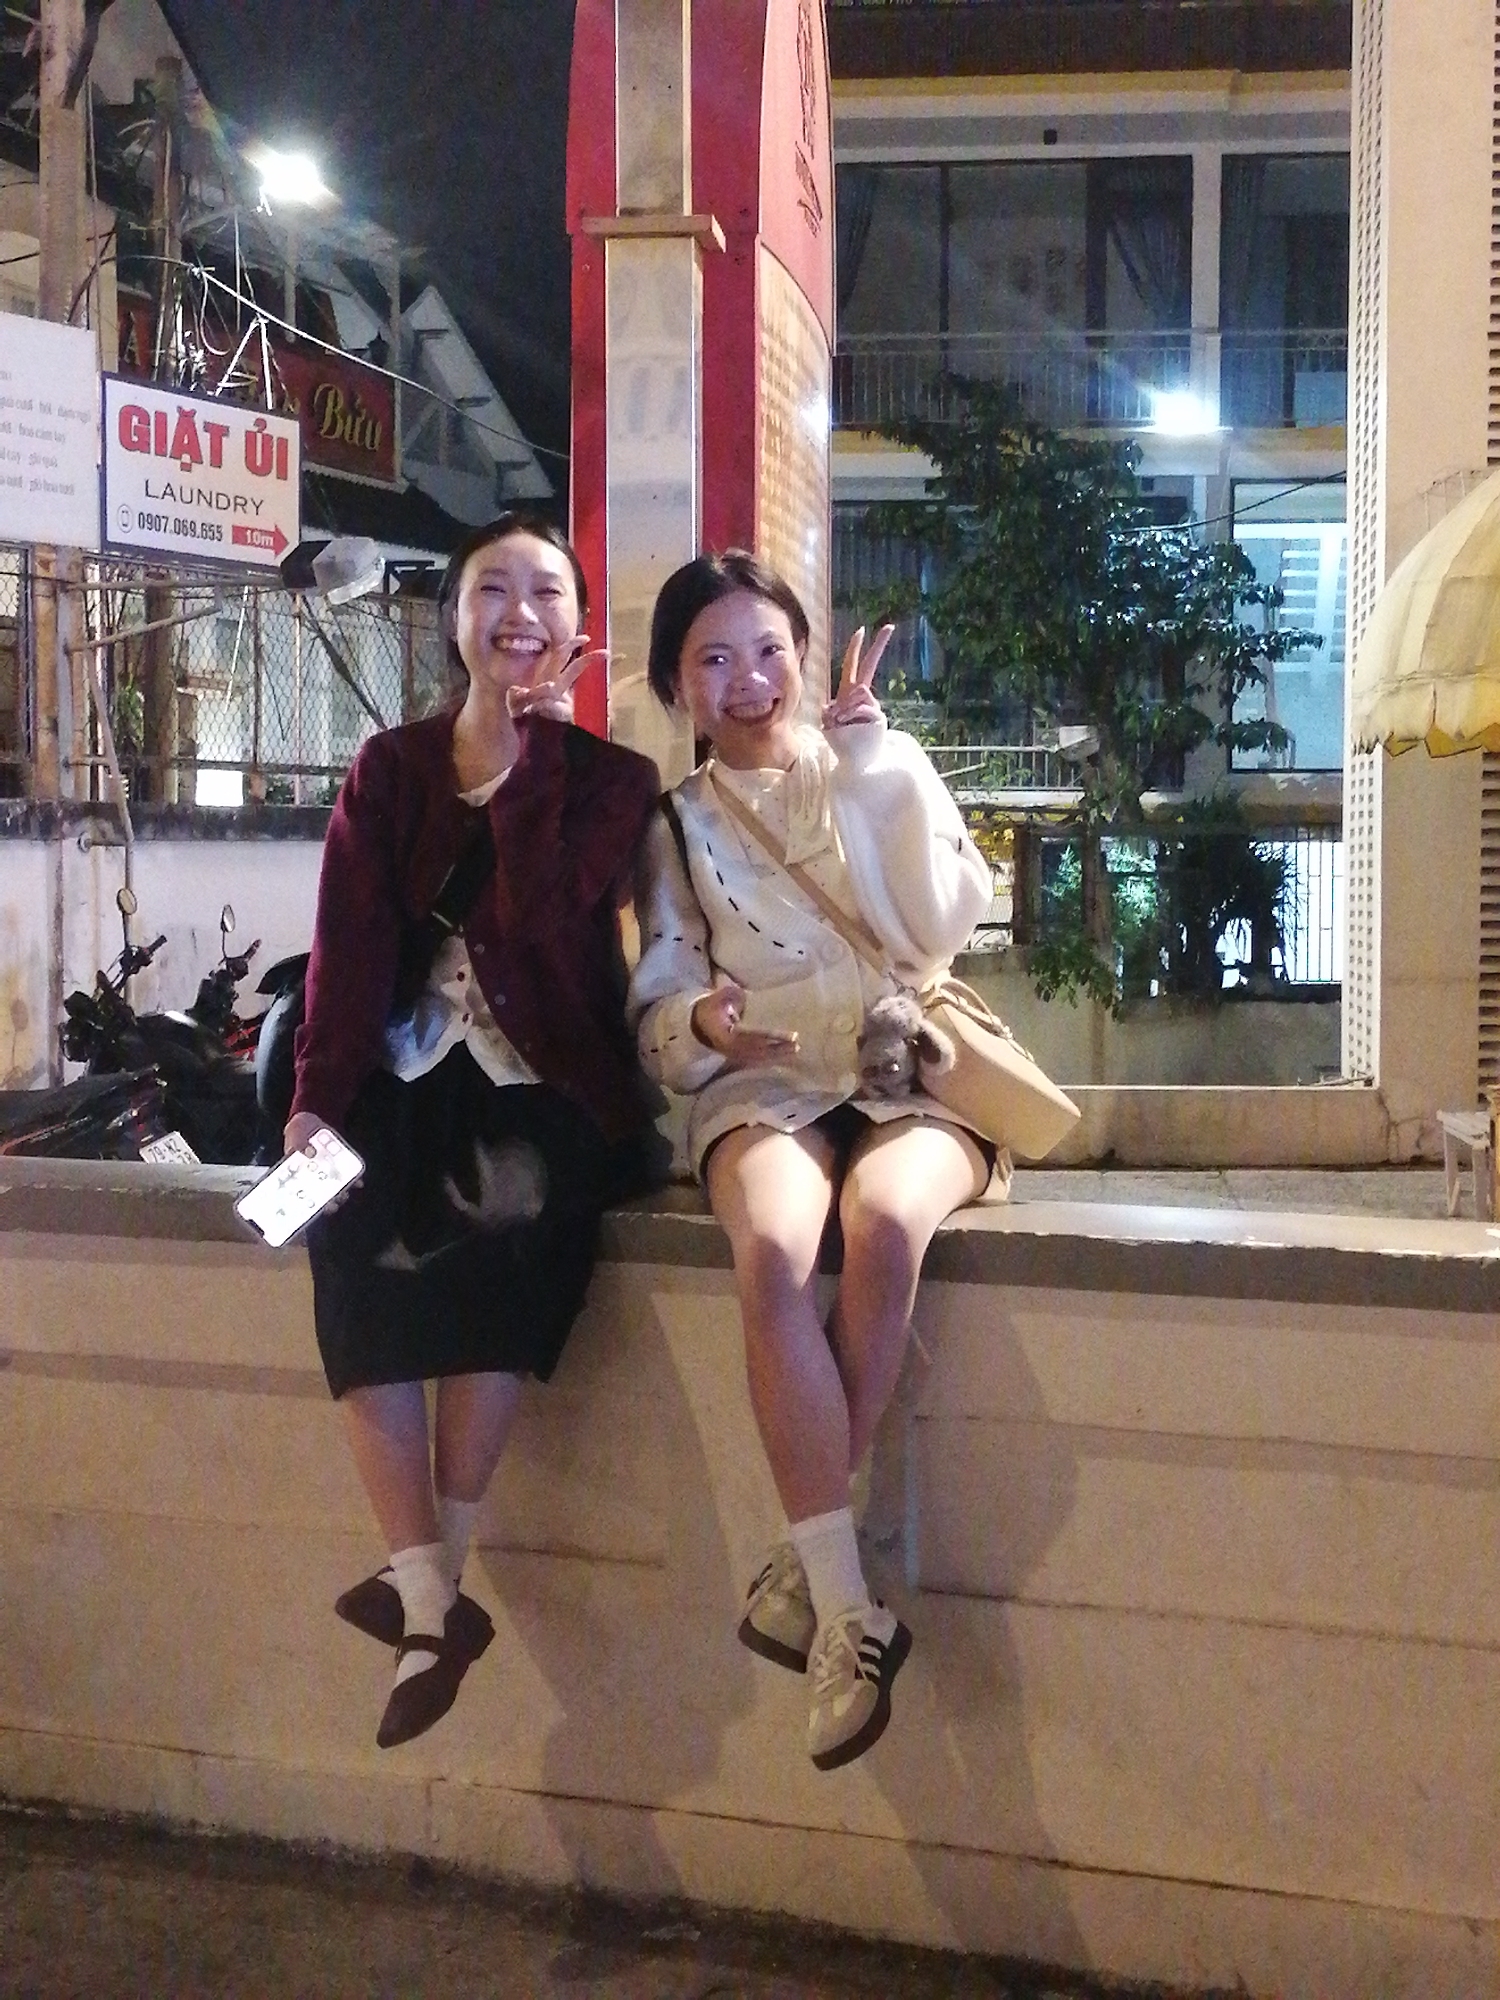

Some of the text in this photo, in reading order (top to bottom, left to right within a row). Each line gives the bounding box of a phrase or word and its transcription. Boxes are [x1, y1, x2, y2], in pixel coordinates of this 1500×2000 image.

[118, 404, 230, 473] GIẶT
[244, 417, 289, 481] ỦI
[144, 478, 264, 516] LAUNDRY
[138, 511, 274, 547] 0907.069.655 10m
